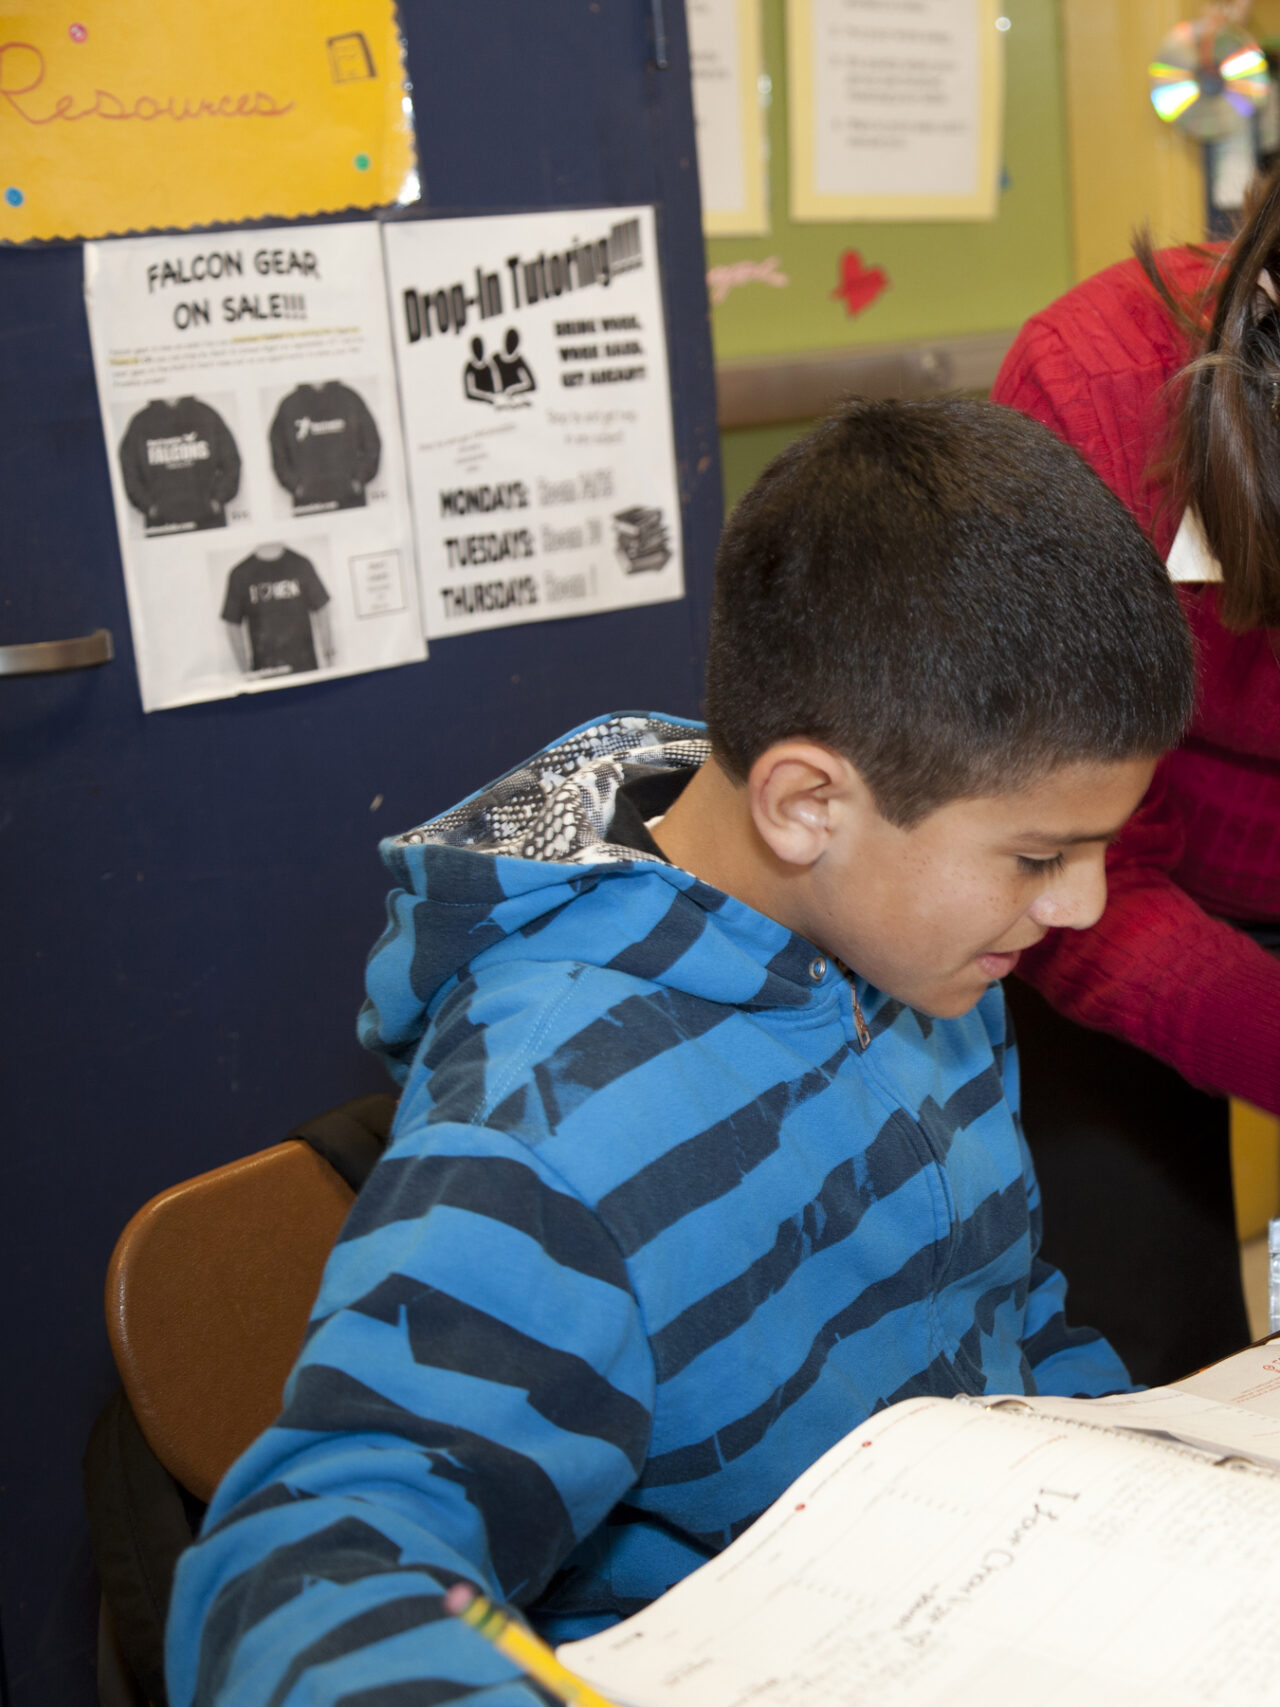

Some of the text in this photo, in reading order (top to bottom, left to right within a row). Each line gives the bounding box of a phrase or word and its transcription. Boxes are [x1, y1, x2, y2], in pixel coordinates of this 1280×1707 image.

[0, 41, 294, 125] Resources
[147, 248, 322, 294] FALCON GEAR
[172, 293, 308, 330] ON SALE!!!
[403, 265, 503, 344] Drop-In
